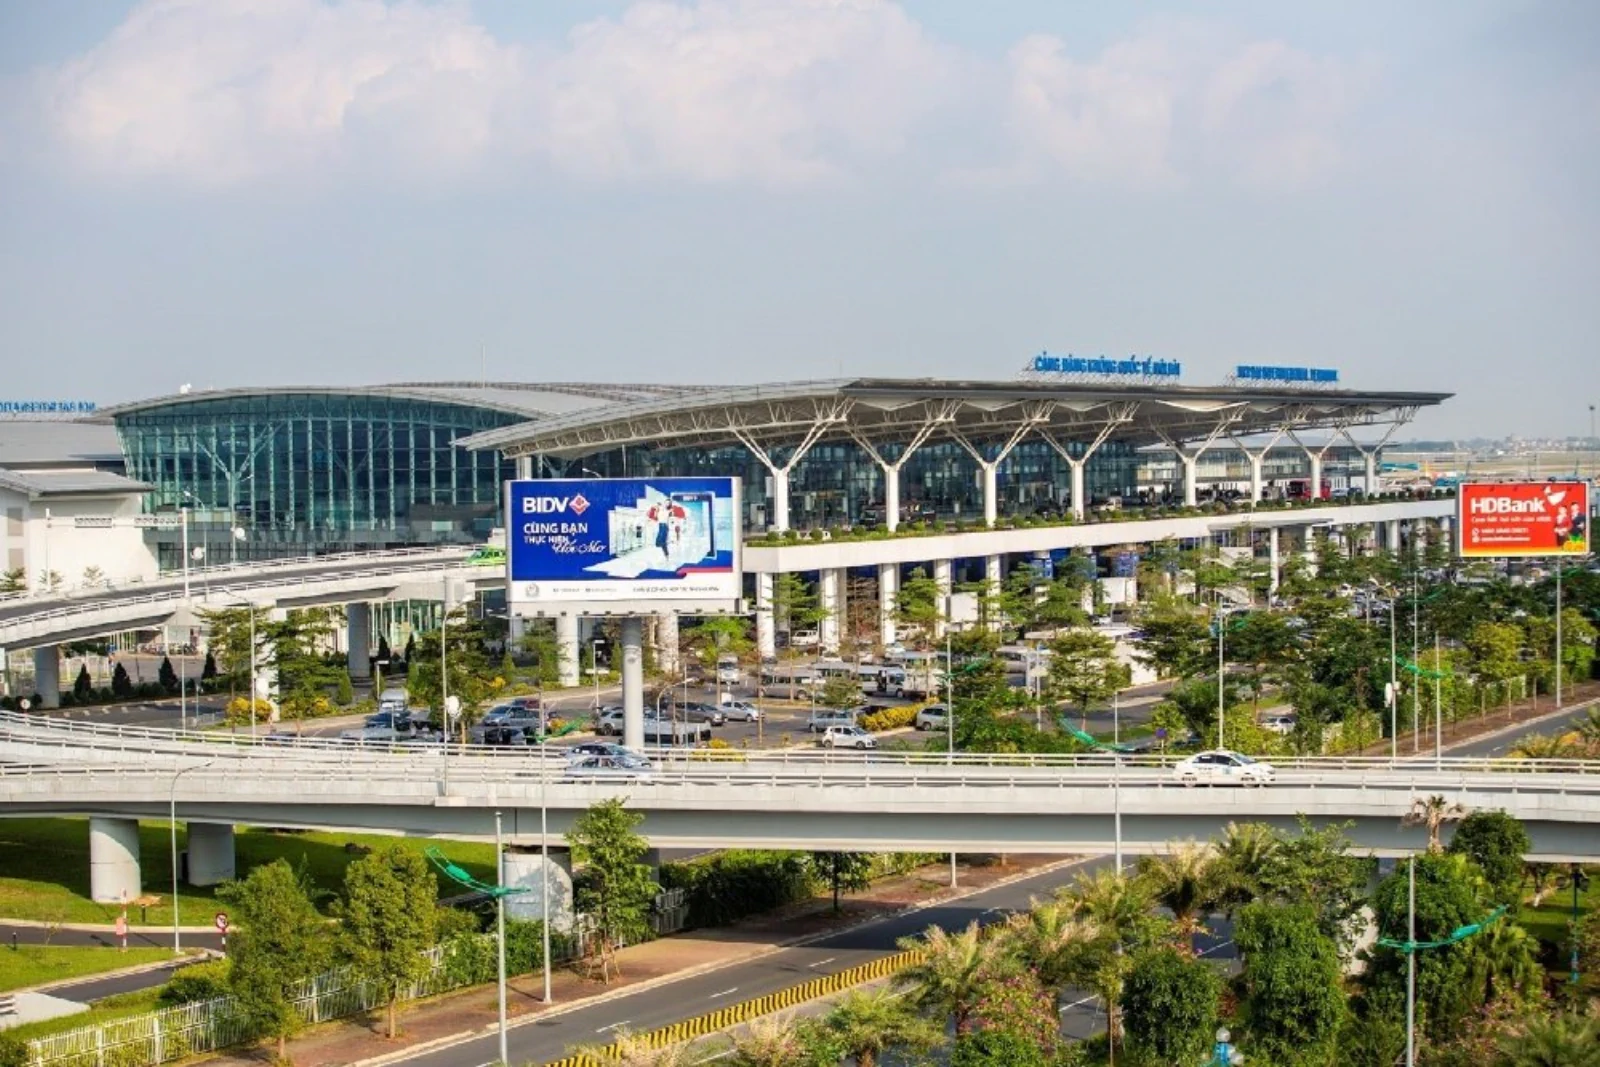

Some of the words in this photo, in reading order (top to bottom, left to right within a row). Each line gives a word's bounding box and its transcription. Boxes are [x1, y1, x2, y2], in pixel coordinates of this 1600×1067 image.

[523, 497, 569, 513] BIDV
[1471, 497, 1546, 513] HDBank
[523, 521, 559, 534] CÙNG
[561, 522, 588, 536] BẠN
